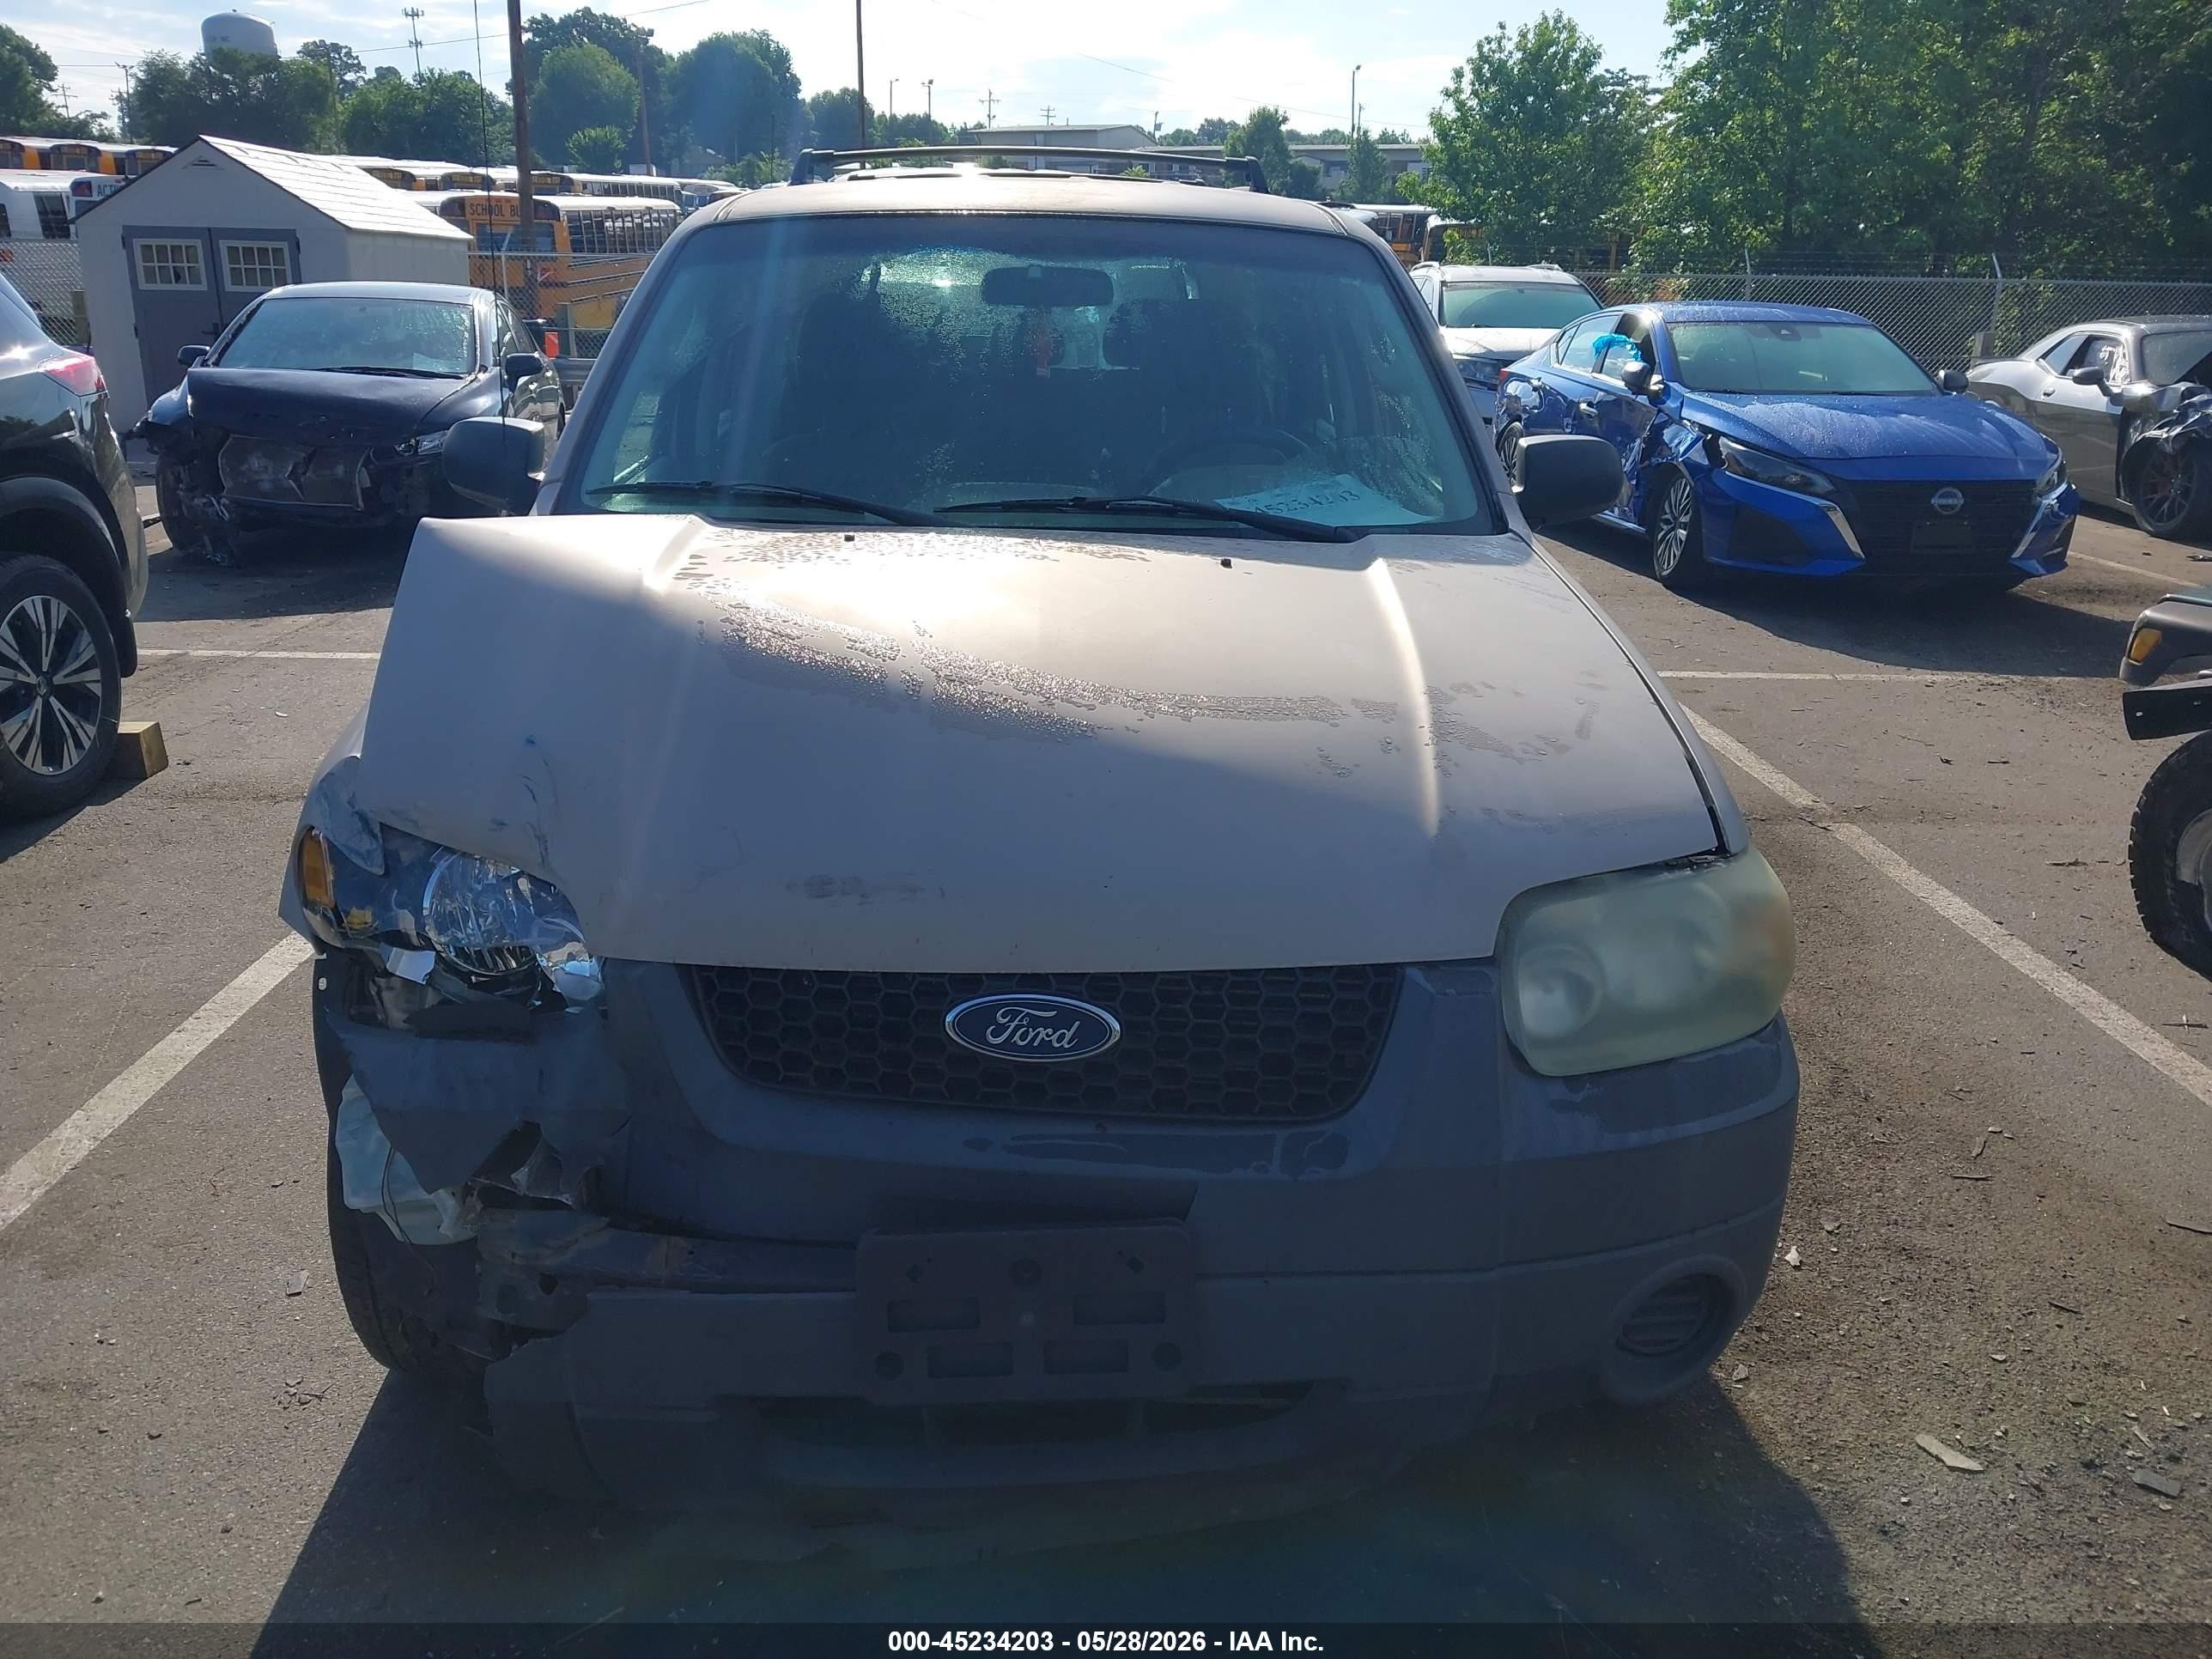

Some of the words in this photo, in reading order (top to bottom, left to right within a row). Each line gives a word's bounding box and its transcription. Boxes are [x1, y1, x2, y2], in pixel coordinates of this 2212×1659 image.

[469, 203, 506, 216] SCHOOL
[510, 204, 521, 217] BU
[986, 1006, 1082, 1049] Ford
